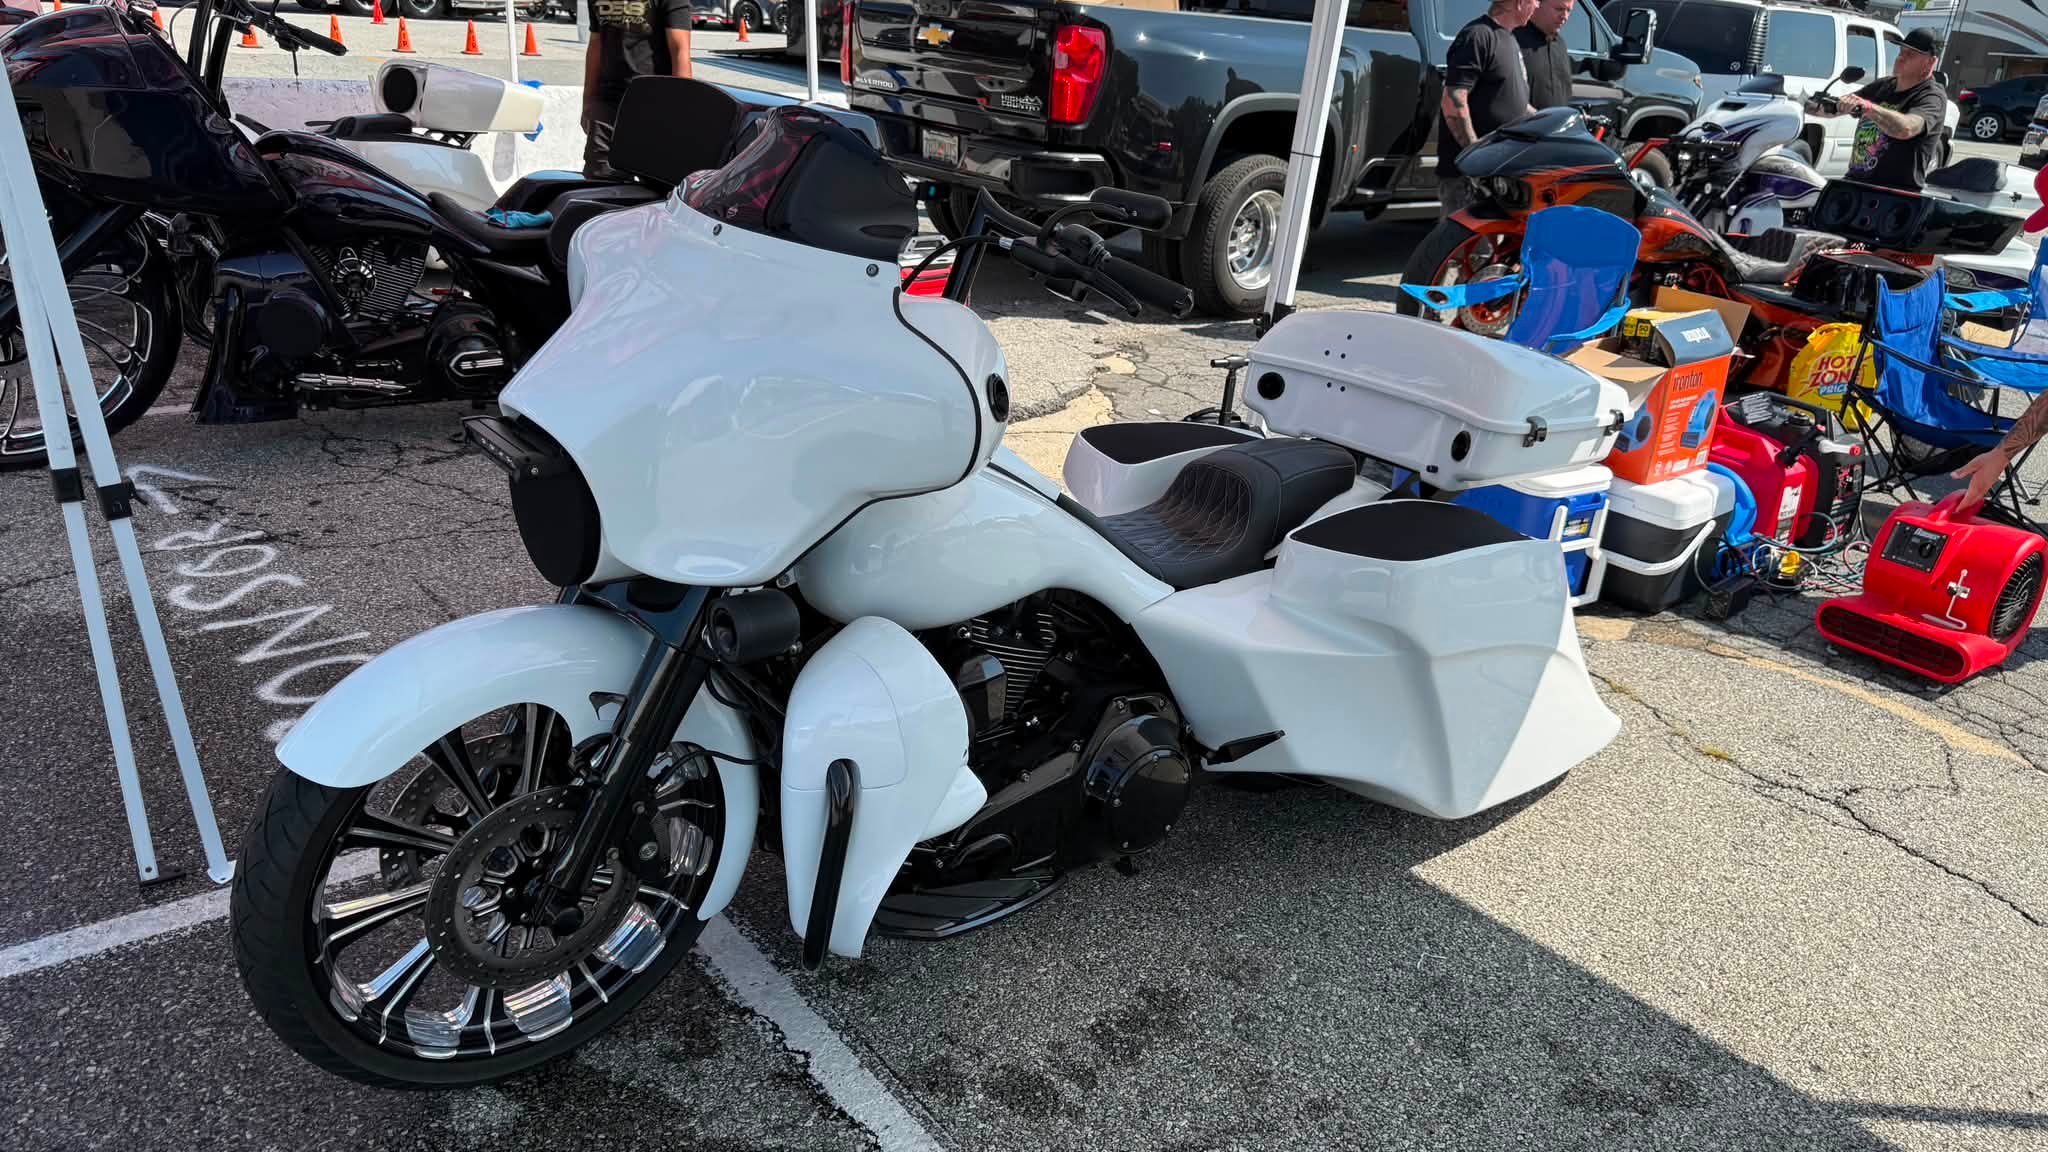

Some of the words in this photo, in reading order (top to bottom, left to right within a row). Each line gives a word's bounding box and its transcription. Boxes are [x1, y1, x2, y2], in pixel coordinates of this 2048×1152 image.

[1817, 355, 1857, 371] HOT
[1809, 367, 1855, 388] ZON
[1819, 383, 1849, 395] PRIC
